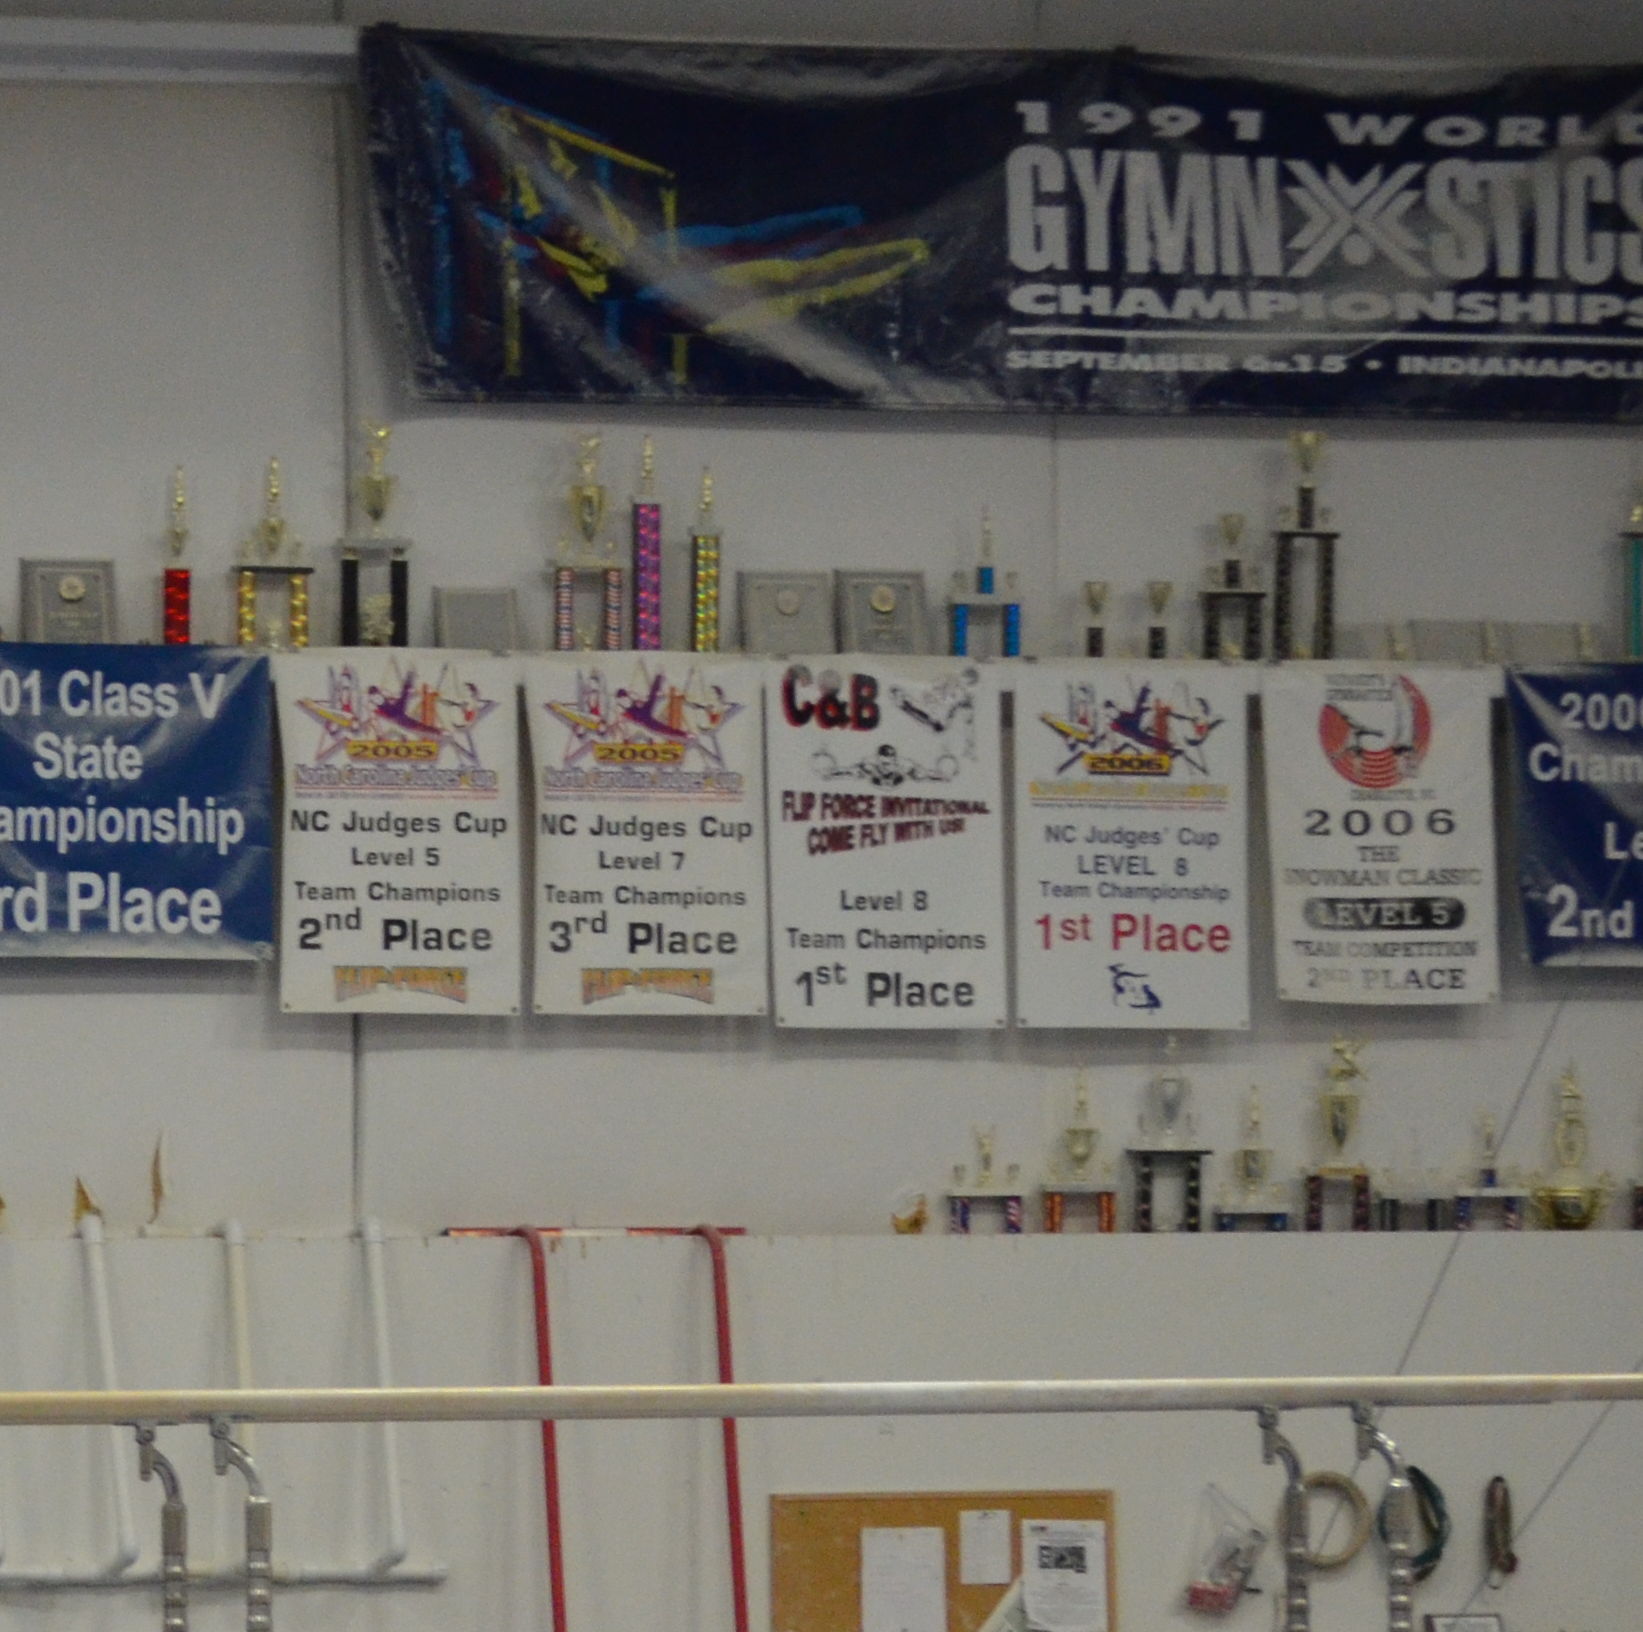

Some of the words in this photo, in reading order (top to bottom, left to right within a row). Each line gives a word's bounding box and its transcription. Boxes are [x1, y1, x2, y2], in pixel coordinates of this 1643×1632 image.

[1015, 101, 1264, 142] 1991
[1006, 350, 1230, 373] SEPTEMBER
[58, 670, 179, 719] Class
[188, 672, 227, 719] V
[781, 664, 880, 731] C&B
[1559, 692, 1643, 732] 200
[33, 731, 144, 780] State
[350, 743, 435, 760] 2005
[597, 745, 681, 762] 2005
[781, 790, 816, 822] FLIP
[820, 792, 876, 820] FORCE
[881, 796, 991, 818] INVITATIONAL
[291, 810, 330, 833] NC
[342, 810, 441, 835] Judges
[454, 811, 508, 839] Cup
[541, 814, 578, 836] NC
[590, 814, 687, 841] Judges
[699, 816, 754, 843] Cup
[1044, 824, 1076, 843] NC
[1177, 827, 1220, 849] Cup
[1304, 808, 1456, 837] 2006
[807, 824, 855, 857] COME
[859, 822, 889, 848] FLY
[1357, 845, 1400, 862] THE
[351, 847, 414, 867] Level
[426, 847, 441, 867] 5
[599, 851, 661, 871] Level
[671, 852, 685, 870] 7
[1077, 854, 1156, 876] LEVEL
[66, 871, 223, 935] Place
[294, 881, 356, 902] Team
[368, 882, 501, 907] Champions
[544, 885, 603, 905] Team
[614, 886, 746, 910] Champions
[840, 889, 903, 911] Level
[1039, 880, 1091, 898] Team
[1097, 881, 1231, 903] Championship
[1318, 900, 1425, 926] LEVEL
[1431, 899, 1451, 925] 5
[1547, 883, 1634, 938] 2nd
[298, 906, 362, 952] 2nd
[381, 919, 493, 953] Place
[549, 910, 607, 955] 3rd
[627, 922, 738, 956] Place
[786, 927, 846, 949] Team
[856, 928, 987, 954] Champions
[1035, 912, 1091, 950] 1st
[1111, 912, 1231, 952] Place
[1347, 940, 1477, 958] COMPETITION
[795, 962, 847, 1007] 1st
[867, 972, 975, 1008] Place
[1361, 968, 1467, 990] PLACE
